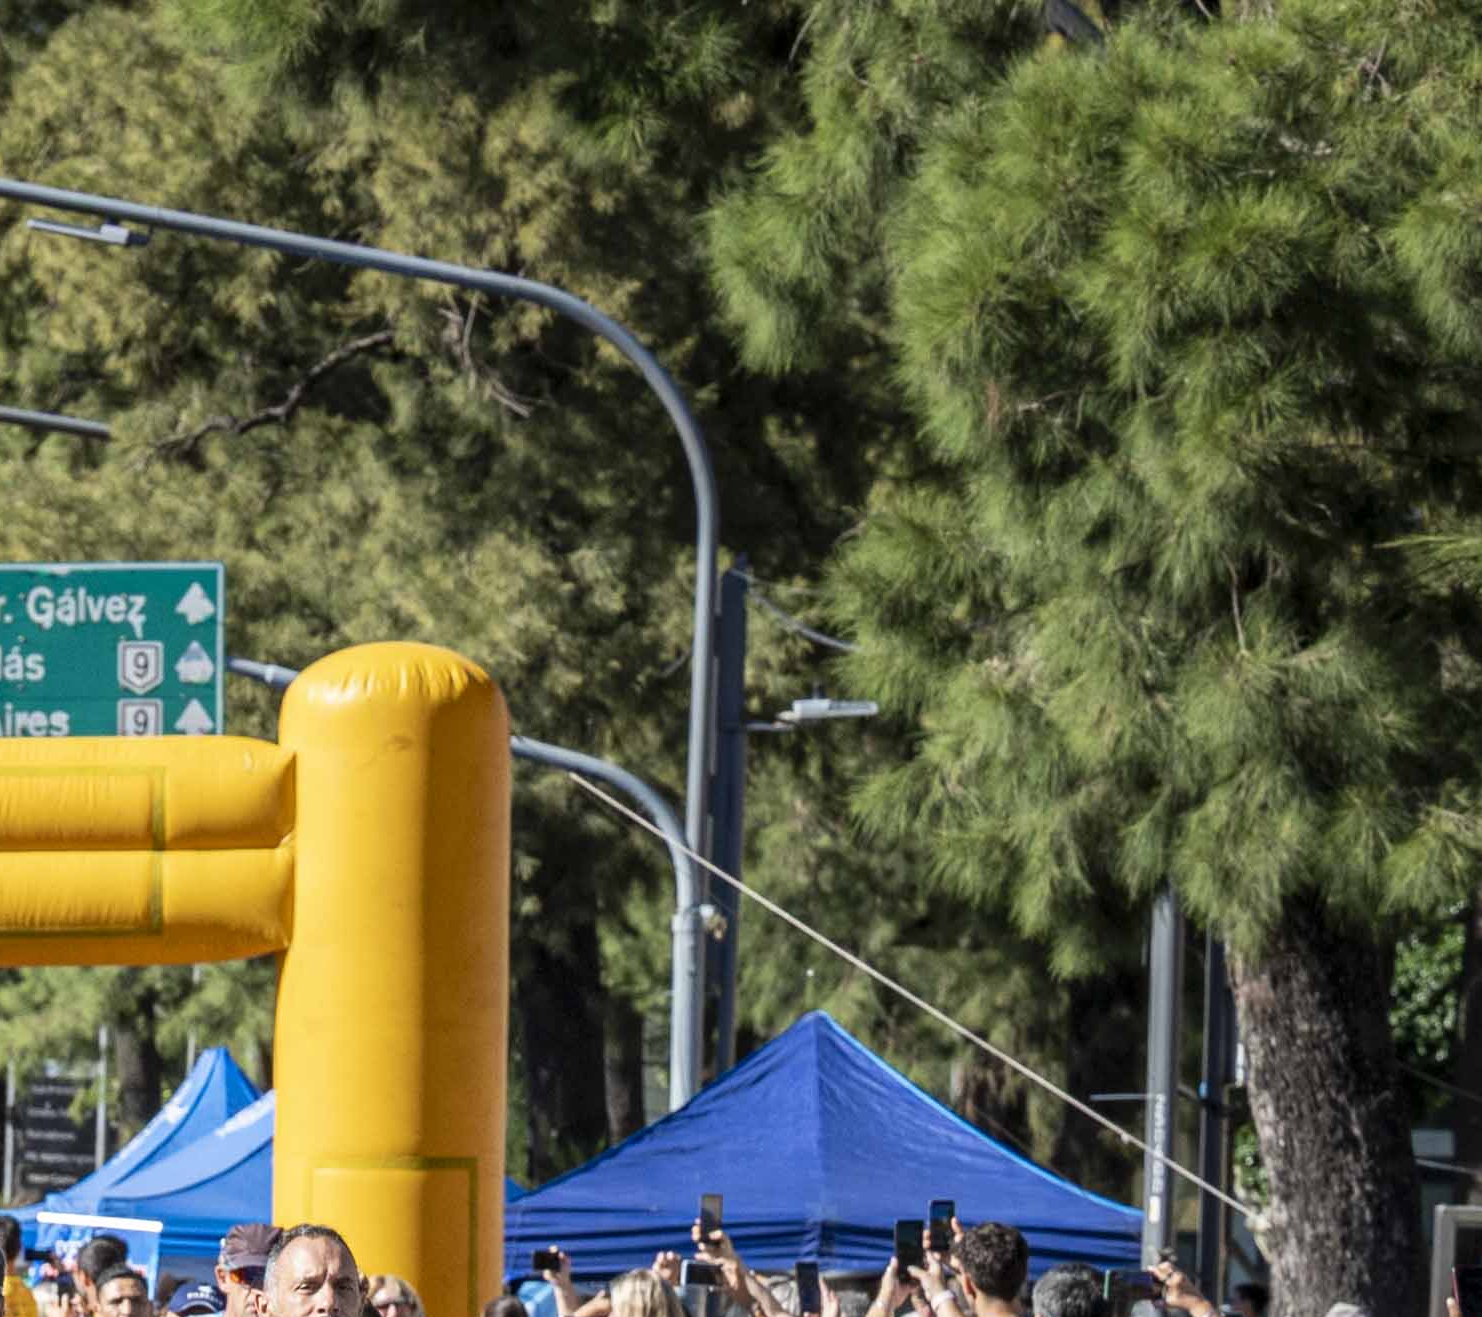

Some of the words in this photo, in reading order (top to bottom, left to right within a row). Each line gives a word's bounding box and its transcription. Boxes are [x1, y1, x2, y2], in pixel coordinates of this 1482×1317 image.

[26, 586, 147, 630] Gálvez
[132, 651, 151, 678] 9
[132, 709, 151, 737] 9
